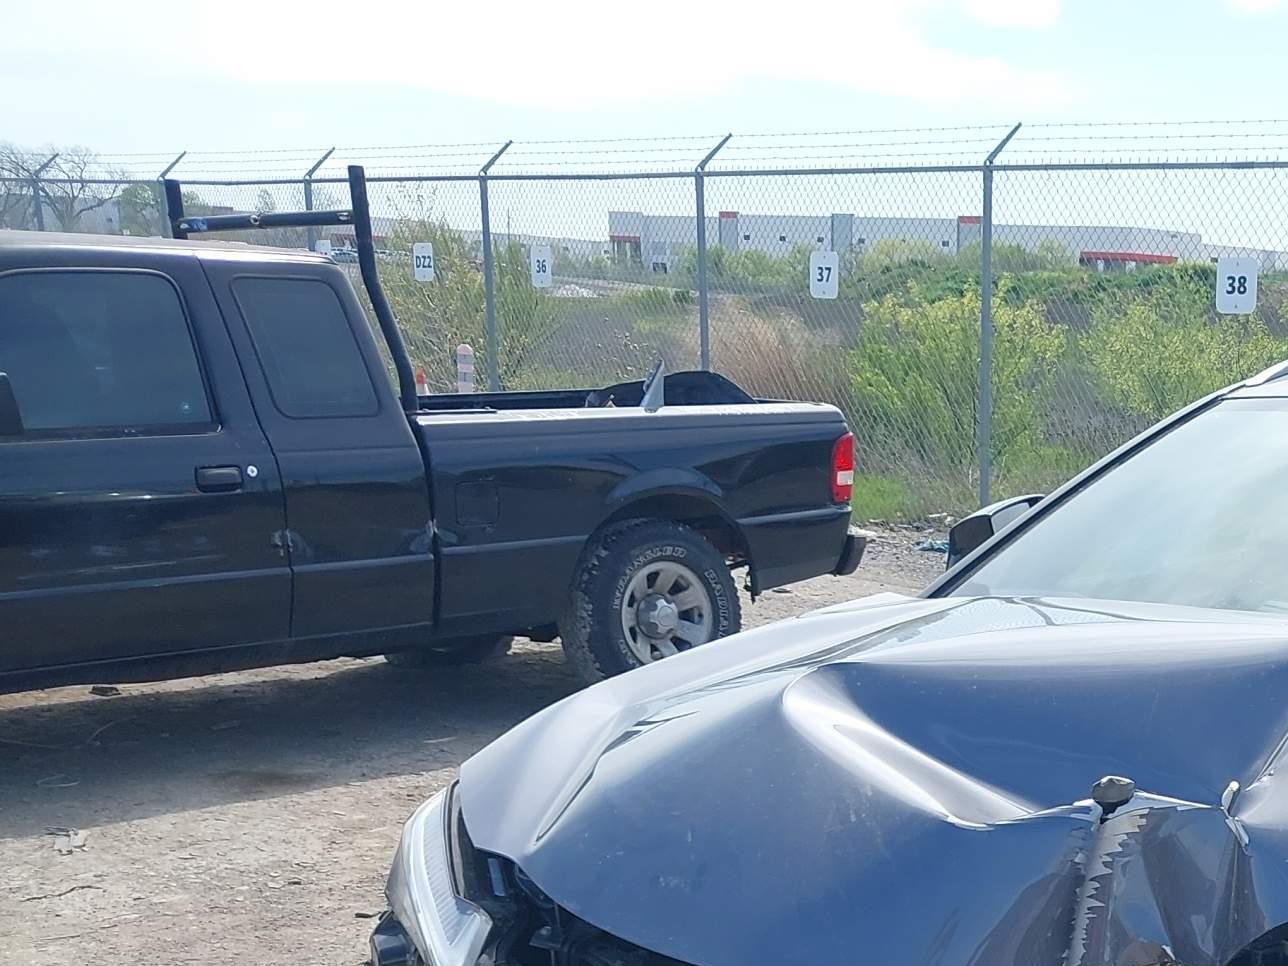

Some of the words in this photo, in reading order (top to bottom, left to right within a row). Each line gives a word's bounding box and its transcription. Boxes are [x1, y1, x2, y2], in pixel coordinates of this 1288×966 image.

[415, 255, 433, 269] DZ2
[535, 259, 548, 274] 36
[816, 266, 833, 283] 37
[1225, 275, 1248, 295] 38
